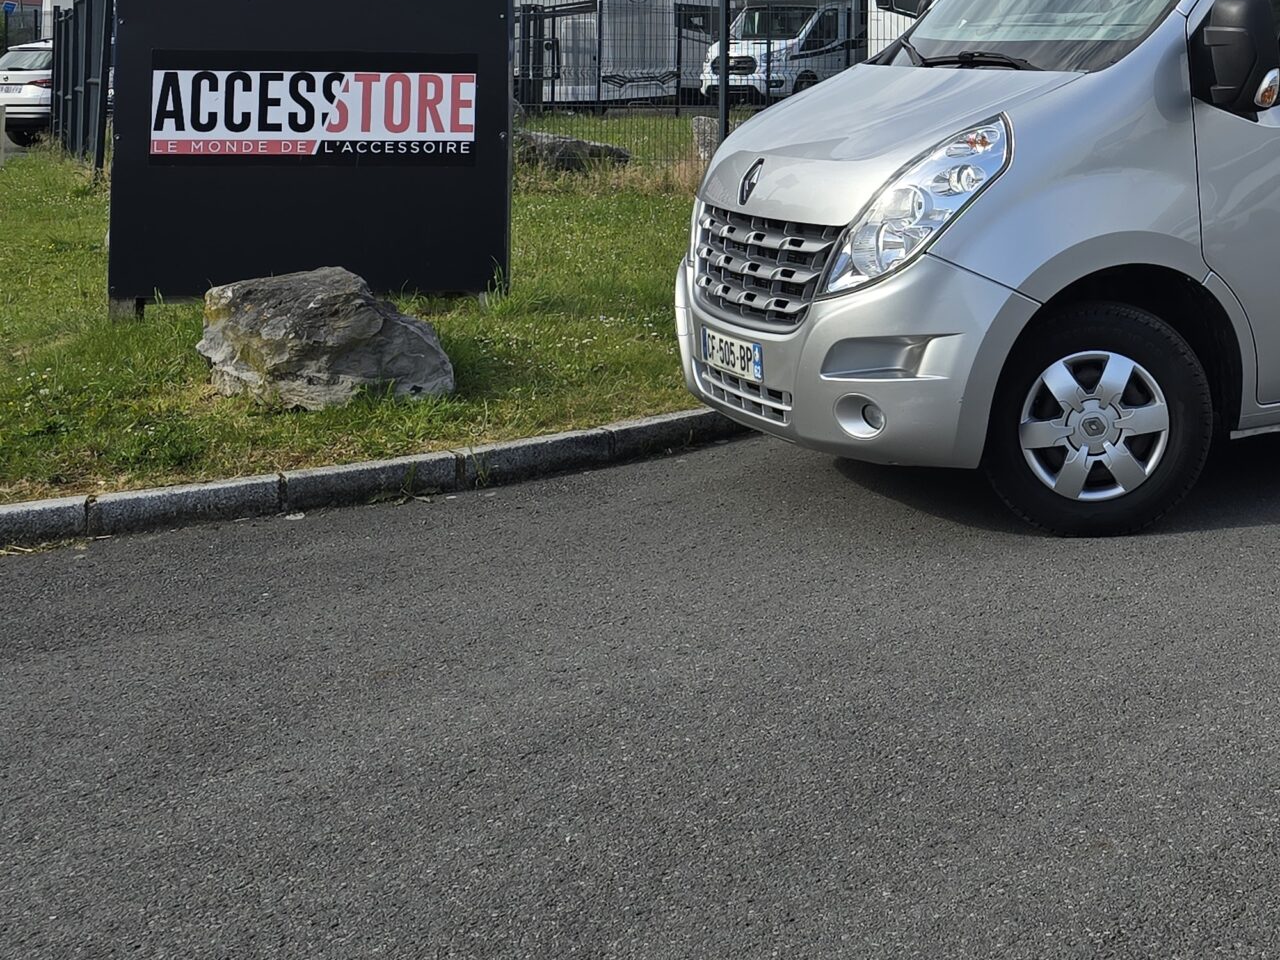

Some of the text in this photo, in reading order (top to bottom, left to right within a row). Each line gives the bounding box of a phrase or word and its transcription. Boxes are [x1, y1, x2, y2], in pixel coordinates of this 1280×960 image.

[153, 141, 471, 155] LE MONDE DE L'ACCESSOIRE
